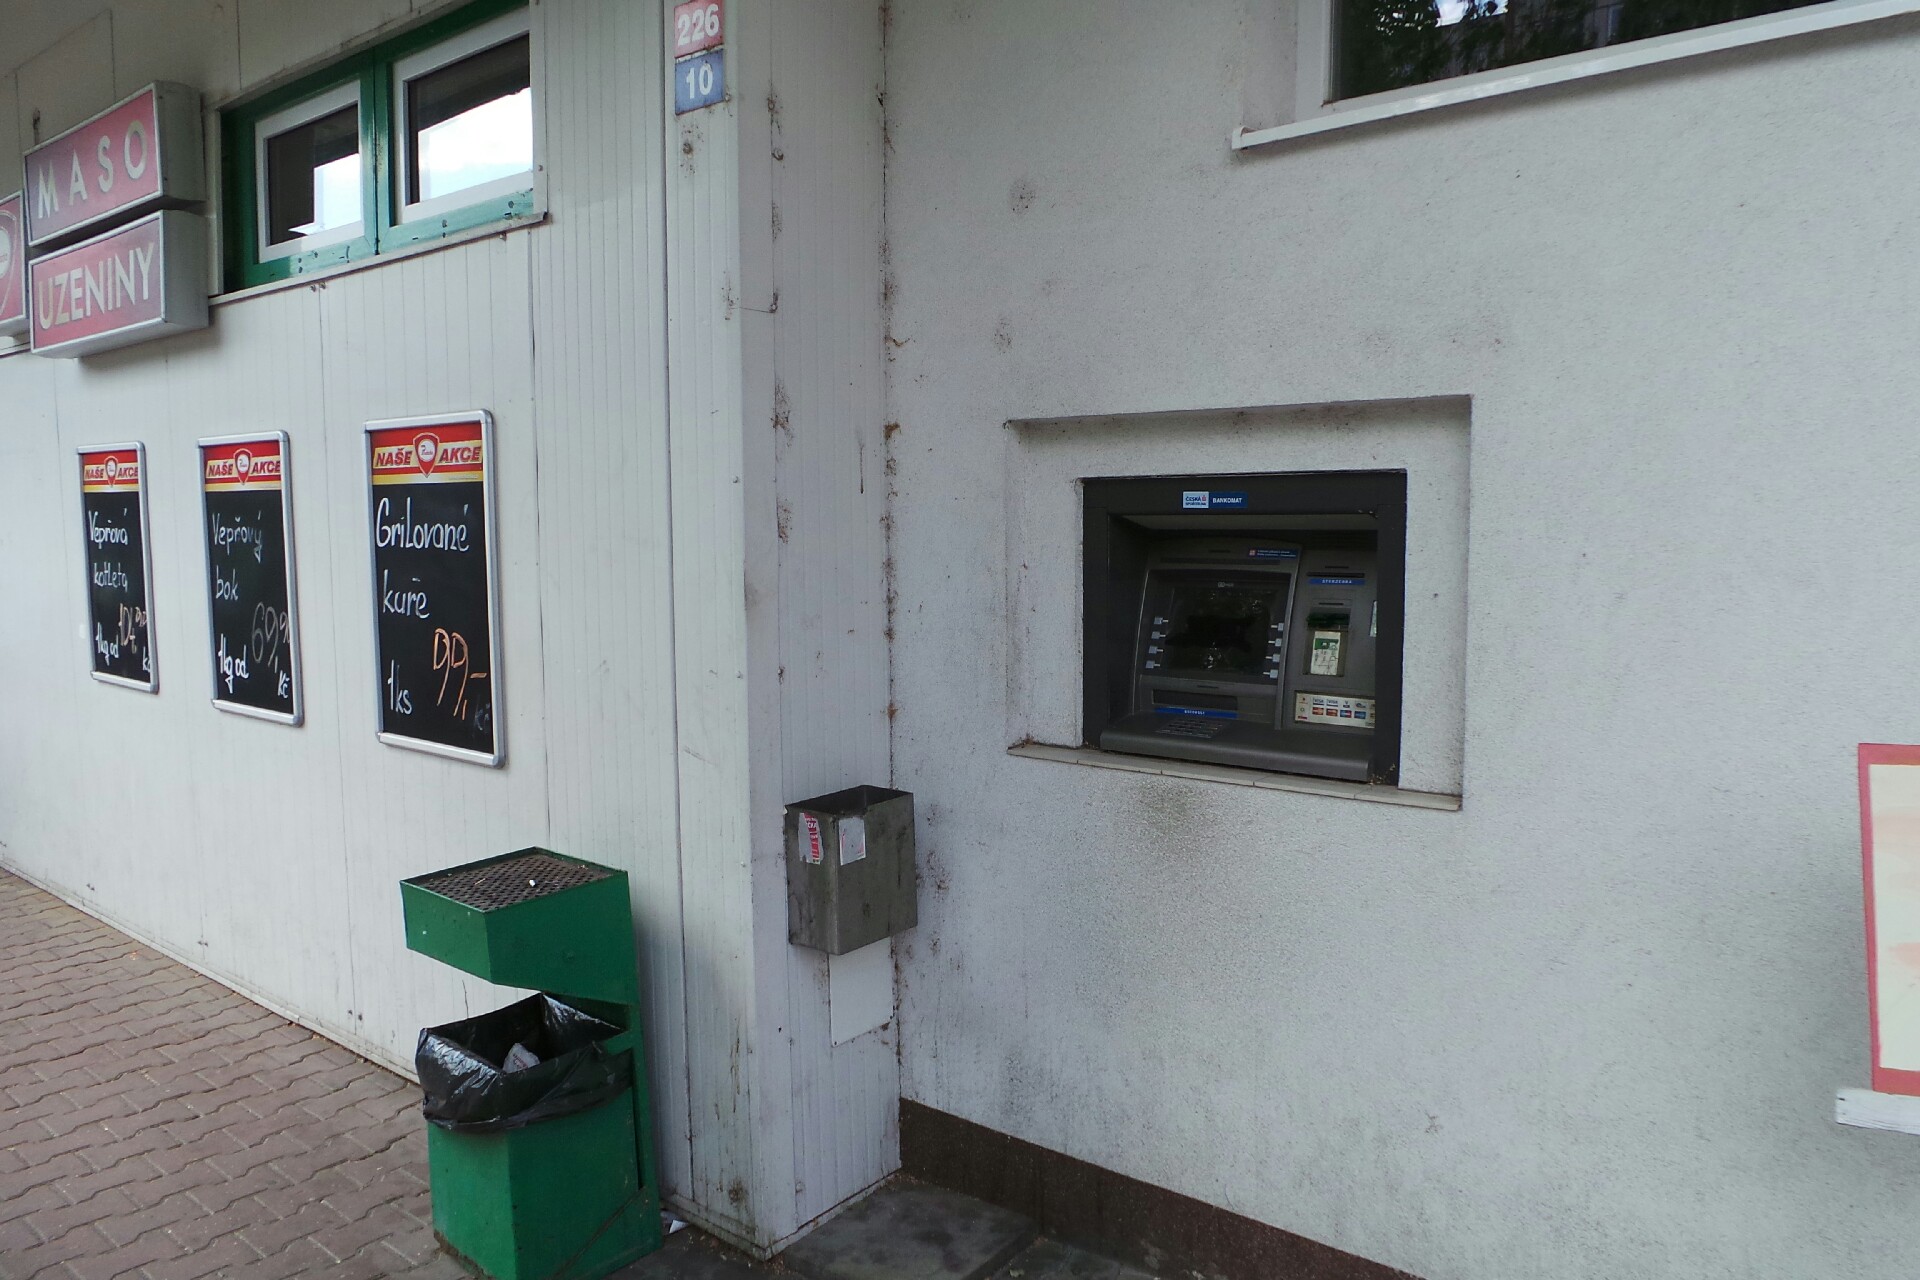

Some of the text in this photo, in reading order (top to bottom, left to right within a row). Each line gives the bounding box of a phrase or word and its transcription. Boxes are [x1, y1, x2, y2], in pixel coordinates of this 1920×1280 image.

[677, 3, 720, 46] 226
[686, 62, 713, 100] 10
[38, 120, 148, 219] MASO
[38, 241, 154, 329] UZENINY
[85, 465, 105, 480] NAŠE
[117, 465, 139, 479] AKCE
[208, 461, 234, 478] NAŠE
[250, 460, 281, 476] AKCE
[375, 447, 413, 467] NAŠE
[438, 447, 482, 464] AKCE
[215, 565, 239, 601] bok
[235, 644, 249, 679] od
[387, 659, 413, 716] 1ks
